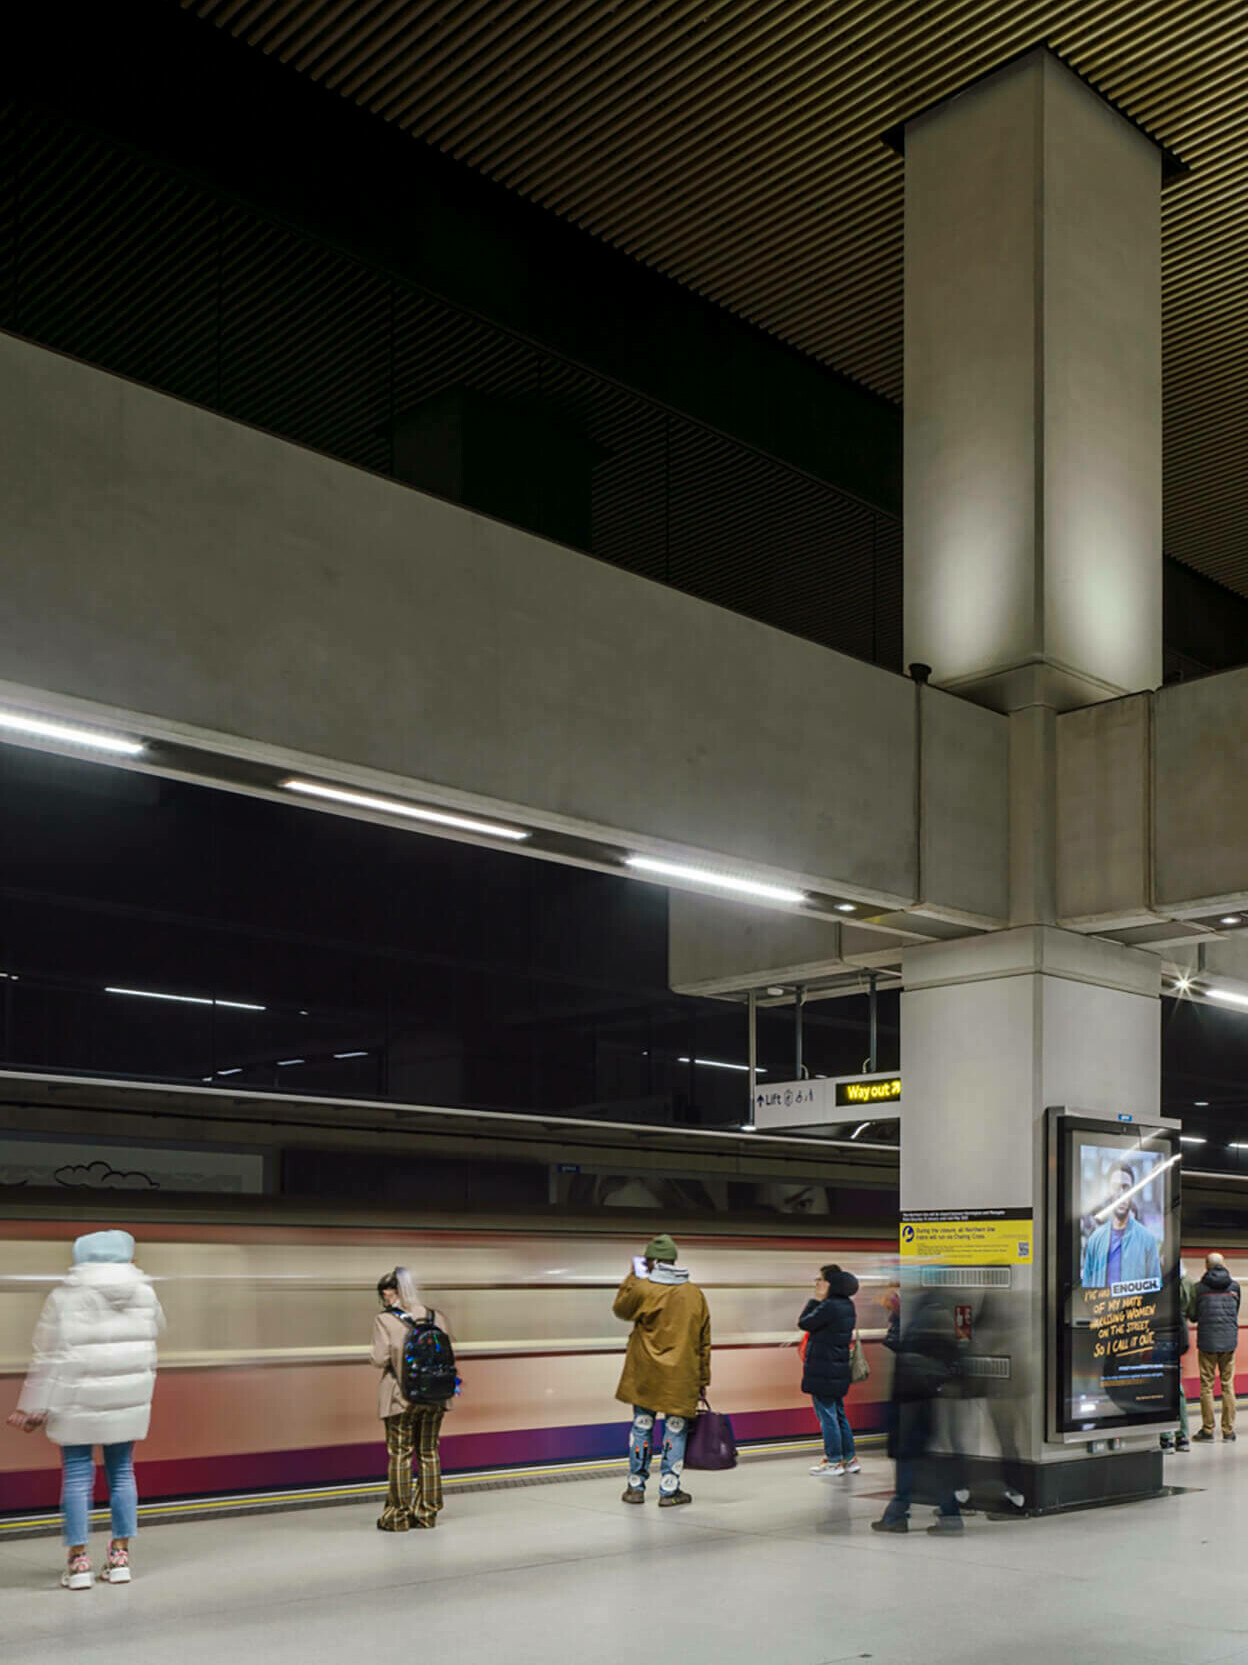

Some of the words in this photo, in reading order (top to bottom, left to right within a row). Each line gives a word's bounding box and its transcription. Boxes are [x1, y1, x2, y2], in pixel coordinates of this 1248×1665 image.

[765, 1093, 781, 1105] Lift
[847, 1085, 870, 1101] Way
[871, 1083, 890, 1097] out
[1093, 1302, 1106, 1314] OF
[1107, 1299, 1120, 1311] MY
[1126, 1303, 1157, 1320] WOMEN
[1098, 1328, 1110, 1339] ON
[1110, 1324, 1125, 1336] THE
[1106, 1341, 1111, 1355] I
[1112, 1338, 1129, 1353] CALL
[1129, 1336, 1139, 1347] IT
